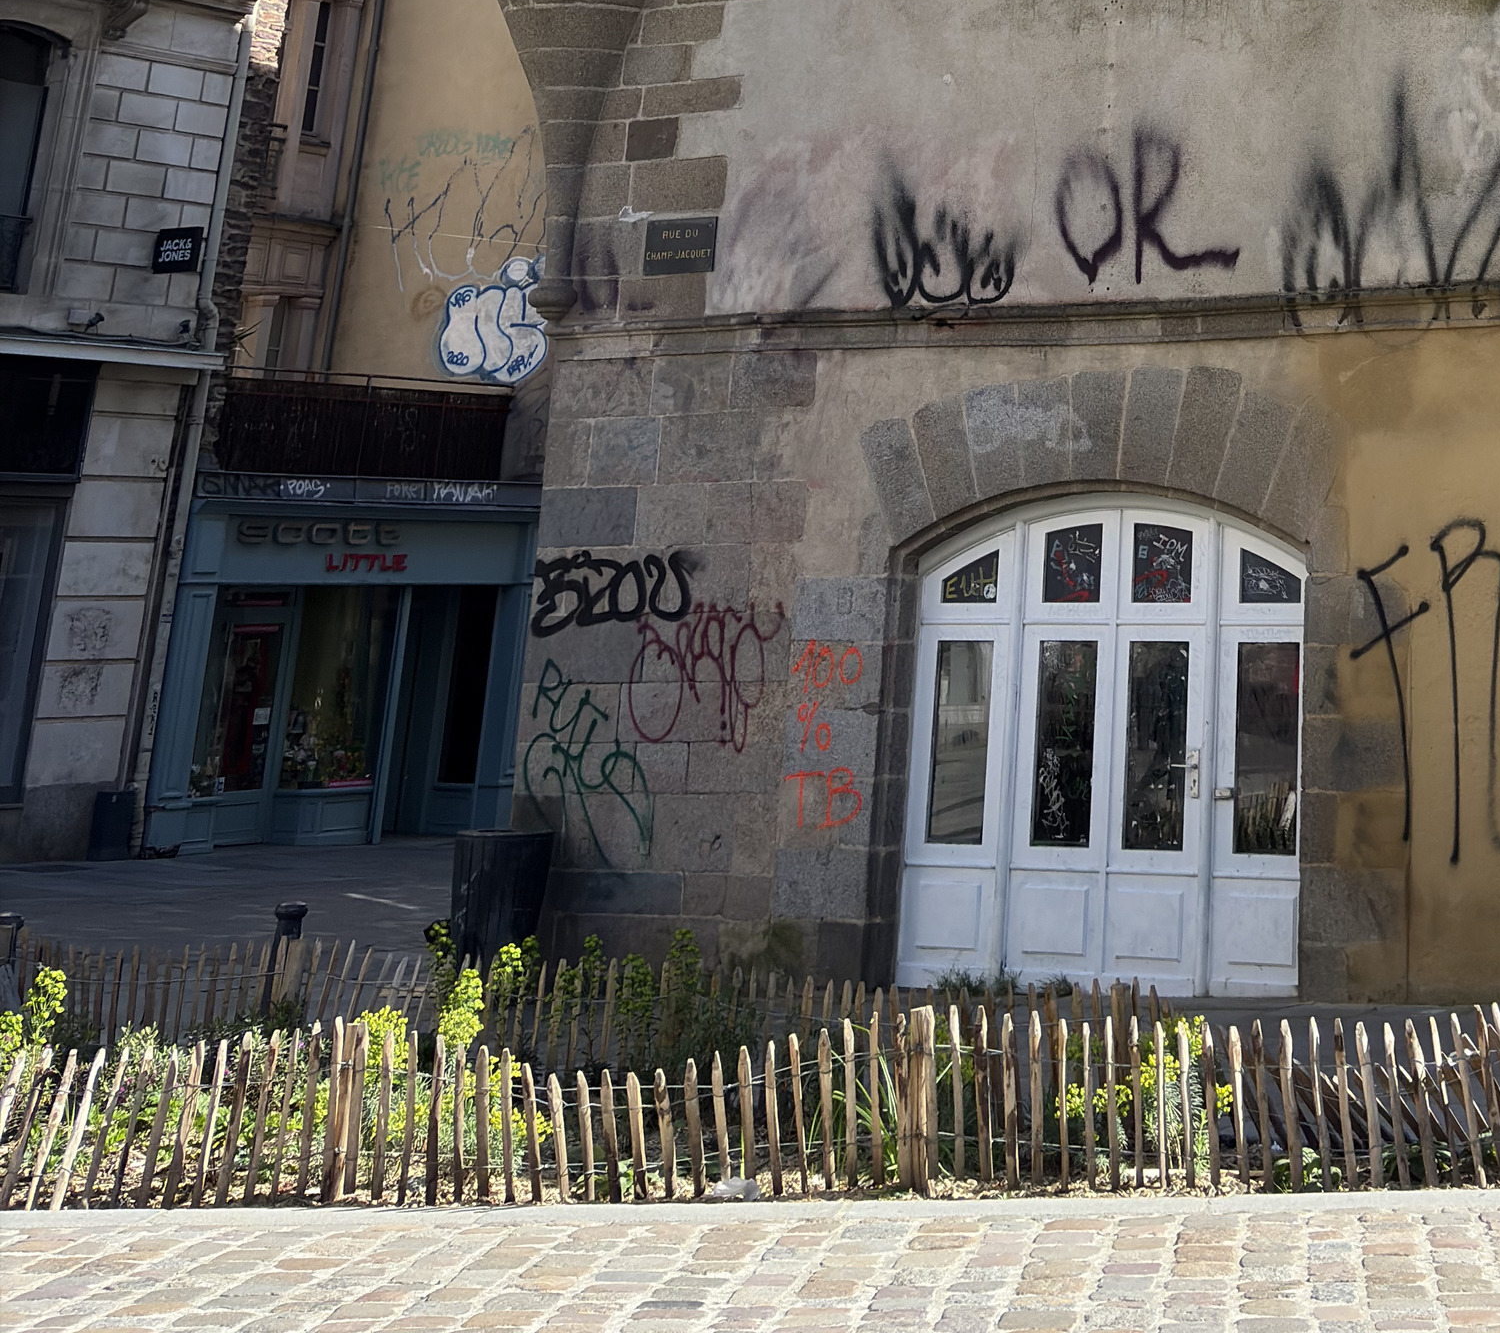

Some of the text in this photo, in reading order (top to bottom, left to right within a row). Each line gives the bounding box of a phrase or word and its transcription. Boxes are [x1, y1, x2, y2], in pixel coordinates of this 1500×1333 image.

[662, 229, 699, 240] RUE DU
[160, 238, 192, 251] JACK&
[158, 249, 191, 263] JONES
[646, 248, 712, 261] CHAMP JACQUET
[326, 553, 407, 573] LITTLE
